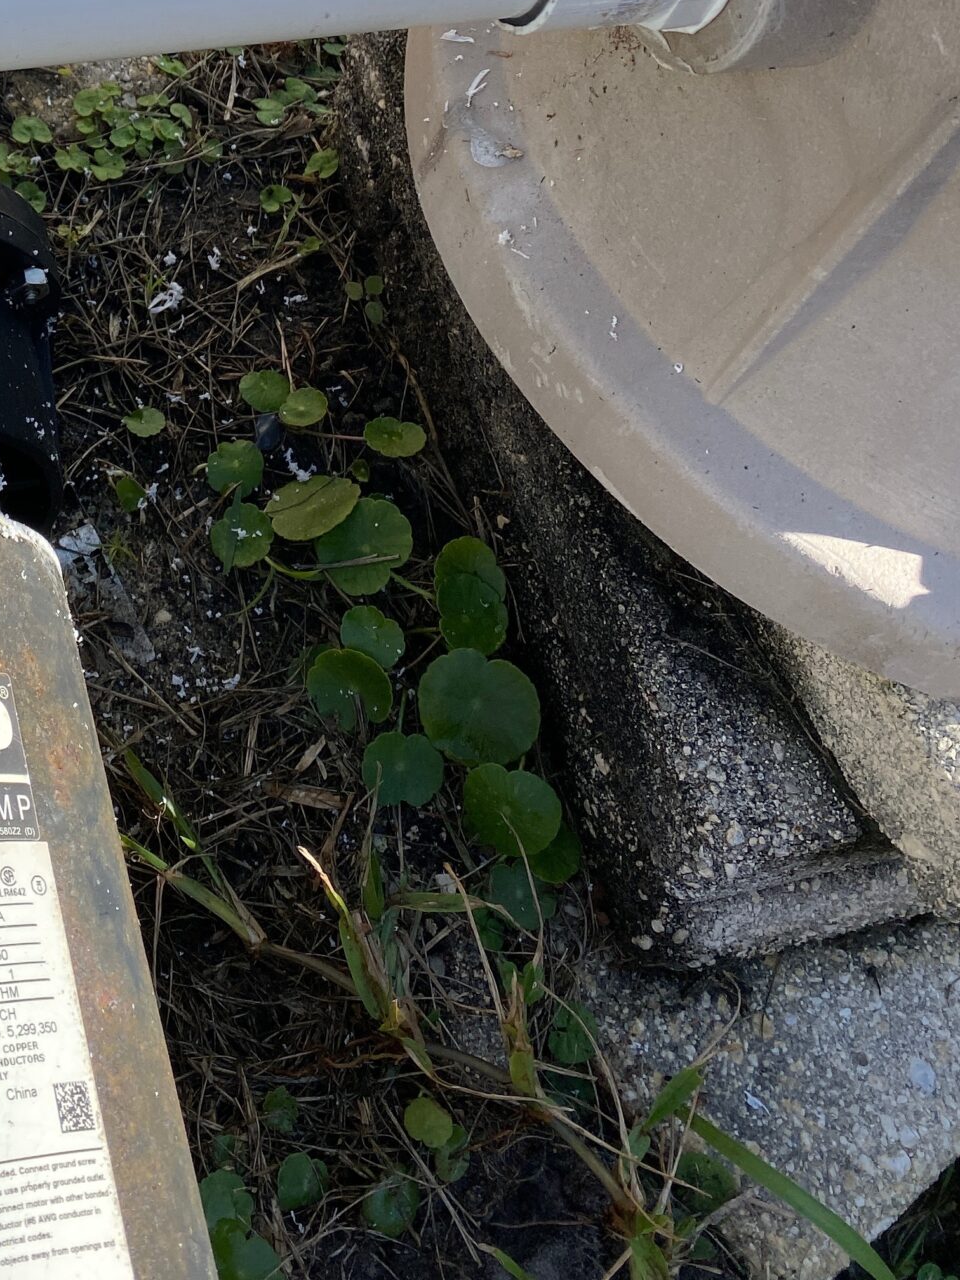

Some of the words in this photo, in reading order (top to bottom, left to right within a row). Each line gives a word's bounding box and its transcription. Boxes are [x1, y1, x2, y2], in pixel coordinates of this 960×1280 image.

[8, 969, 15, 980] 1
[7, 1021, 58, 1039] 5,299,350
[2, 1040, 39, 1054] COPPER
[6, 1087, 38, 1102] China
[18, 1163, 50, 1175] Connect
[51, 1158, 77, 1172] ground
[3, 1186, 19, 1196] use
[52, 1175, 86, 1189] grounded
[25, 1198, 49, 1209] motor
[38, 1212, 58, 1224] AWG
